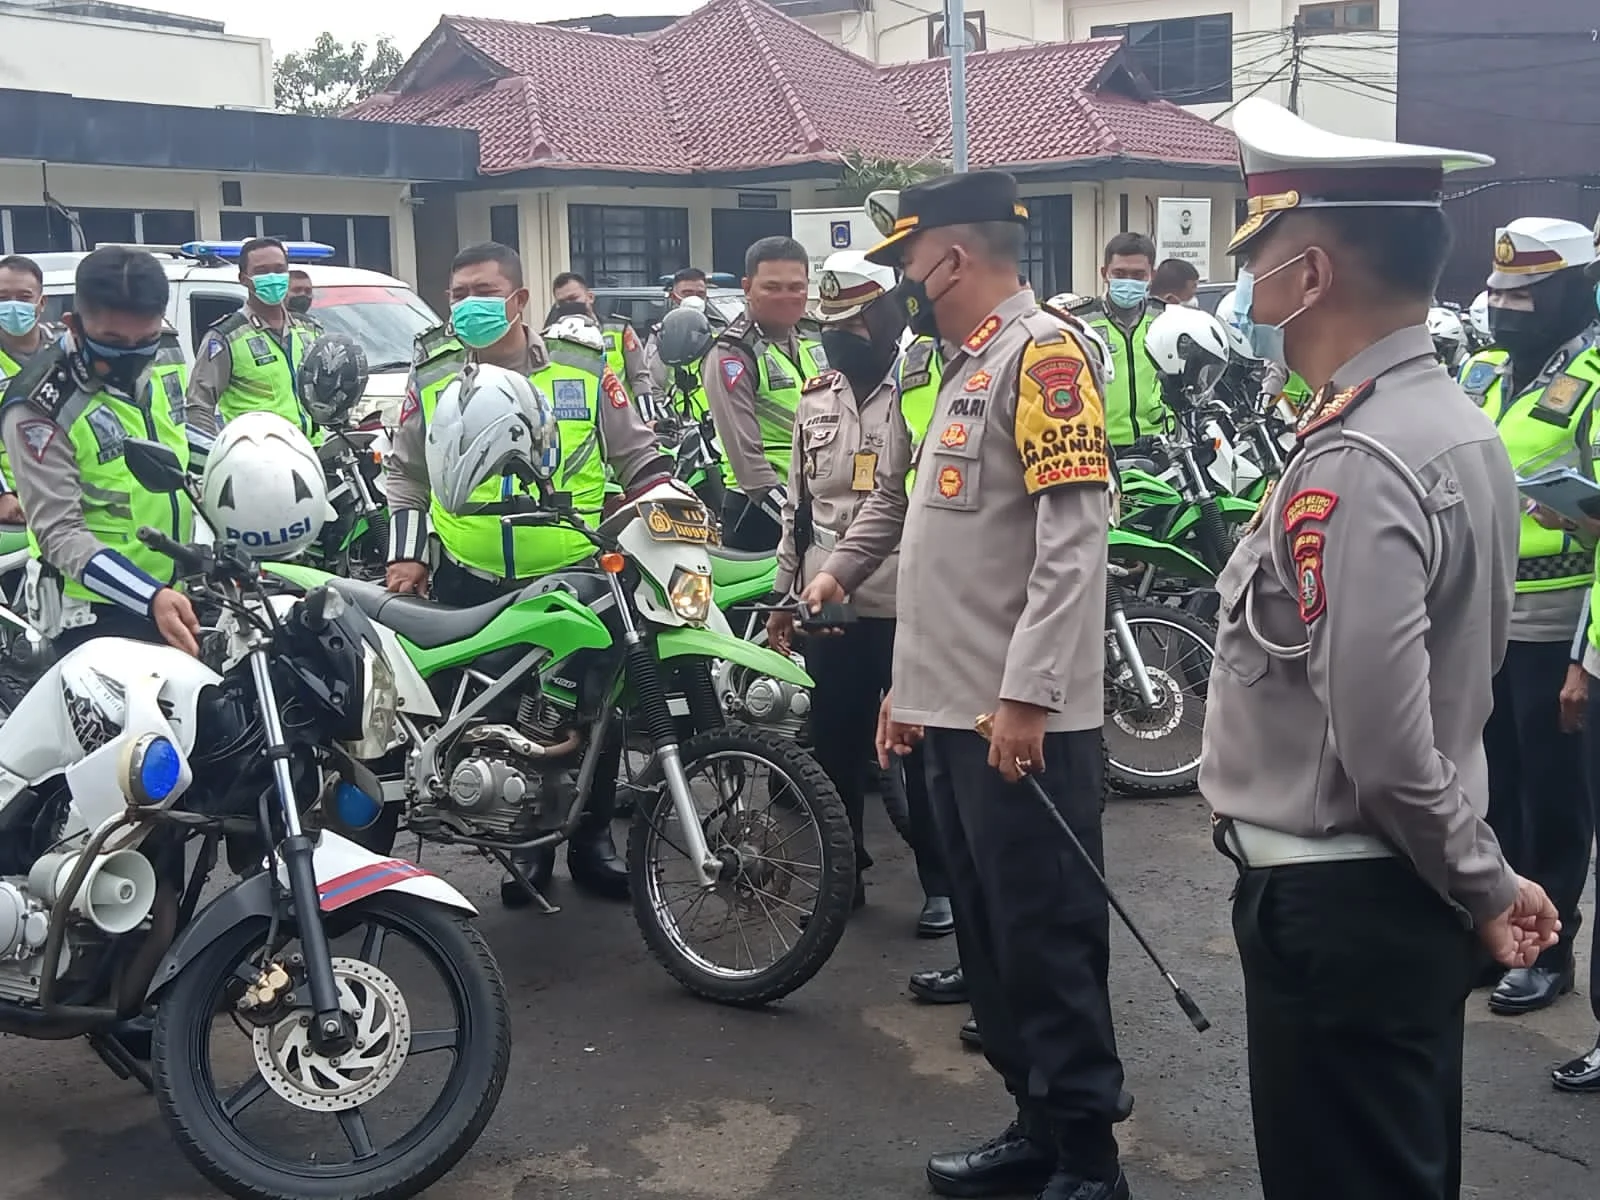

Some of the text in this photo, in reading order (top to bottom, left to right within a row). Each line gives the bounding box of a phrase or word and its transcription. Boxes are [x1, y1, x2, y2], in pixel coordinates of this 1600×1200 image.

[947, 398, 986, 417] POLRI
[1041, 423, 1089, 444] OPS
[1035, 458, 1073, 476] JAYA
[225, 514, 312, 548] POLISI
